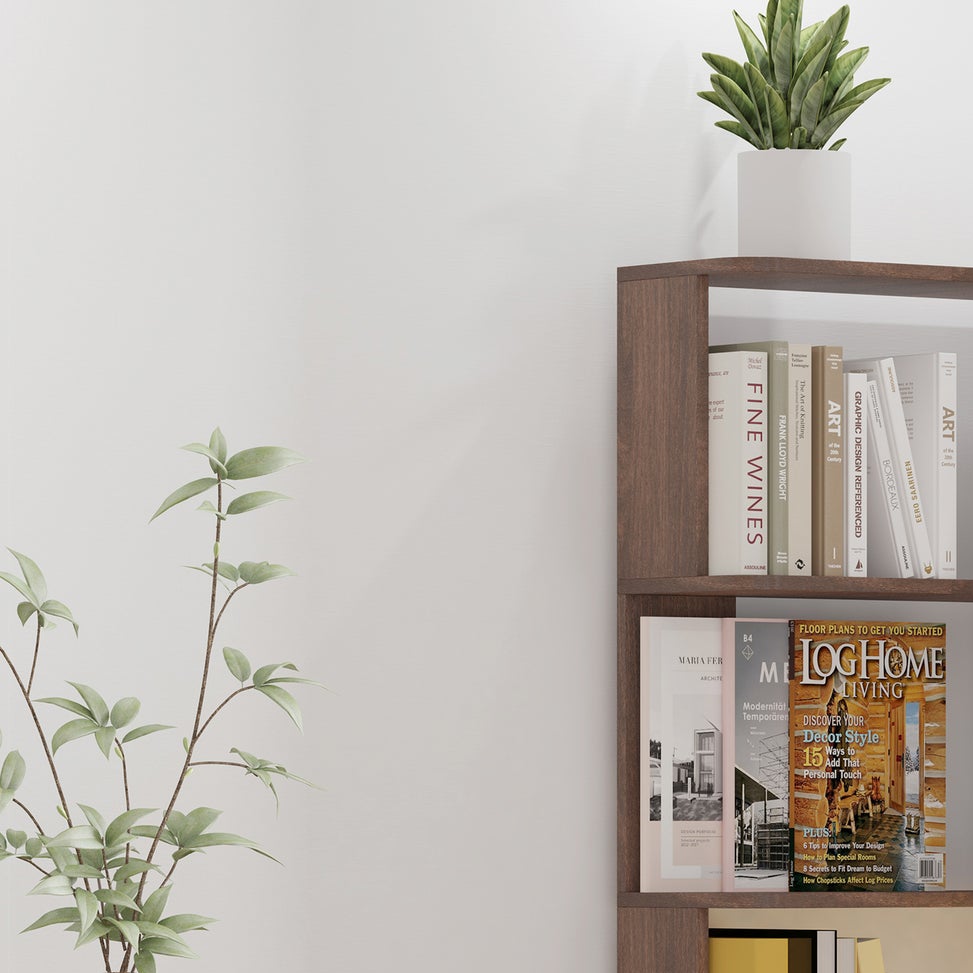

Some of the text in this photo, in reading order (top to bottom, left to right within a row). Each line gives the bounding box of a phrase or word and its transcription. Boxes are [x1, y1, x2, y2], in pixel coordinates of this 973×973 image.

[747, 383, 763, 442] FINE
[828, 400, 841, 437] ART
[942, 406, 954, 442] ART
[779, 415, 787, 501] FRANK LLOYD WRIGHT
[883, 460, 900, 511] BORDEAUX
[905, 460, 922, 524] EERO SAARINEN
[747, 455, 763, 545] WINES
[800, 624, 826, 634] FLOOR
[828, 625, 855, 634] PLANS
[858, 626, 868, 635] TO
[870, 626, 886, 635] GET
[888, 626, 904, 635] YOU
[908, 626, 943, 636] STARTED
[679, 656, 705, 664] MARIA
[843, 682, 904, 699] LIVING
[743, 702, 786, 710] Modernität
[804, 714, 864, 726] DISCOVER YOUR
[803, 730, 880, 747] Decor Style
[803, 747, 824, 767] 15
[826, 746, 856, 756] Ways to
[826, 758, 860, 768] Add That
[804, 770, 862, 779] Personal Touch
[803, 828, 832, 838] PLUS:
[837, 854, 856, 862] Special
